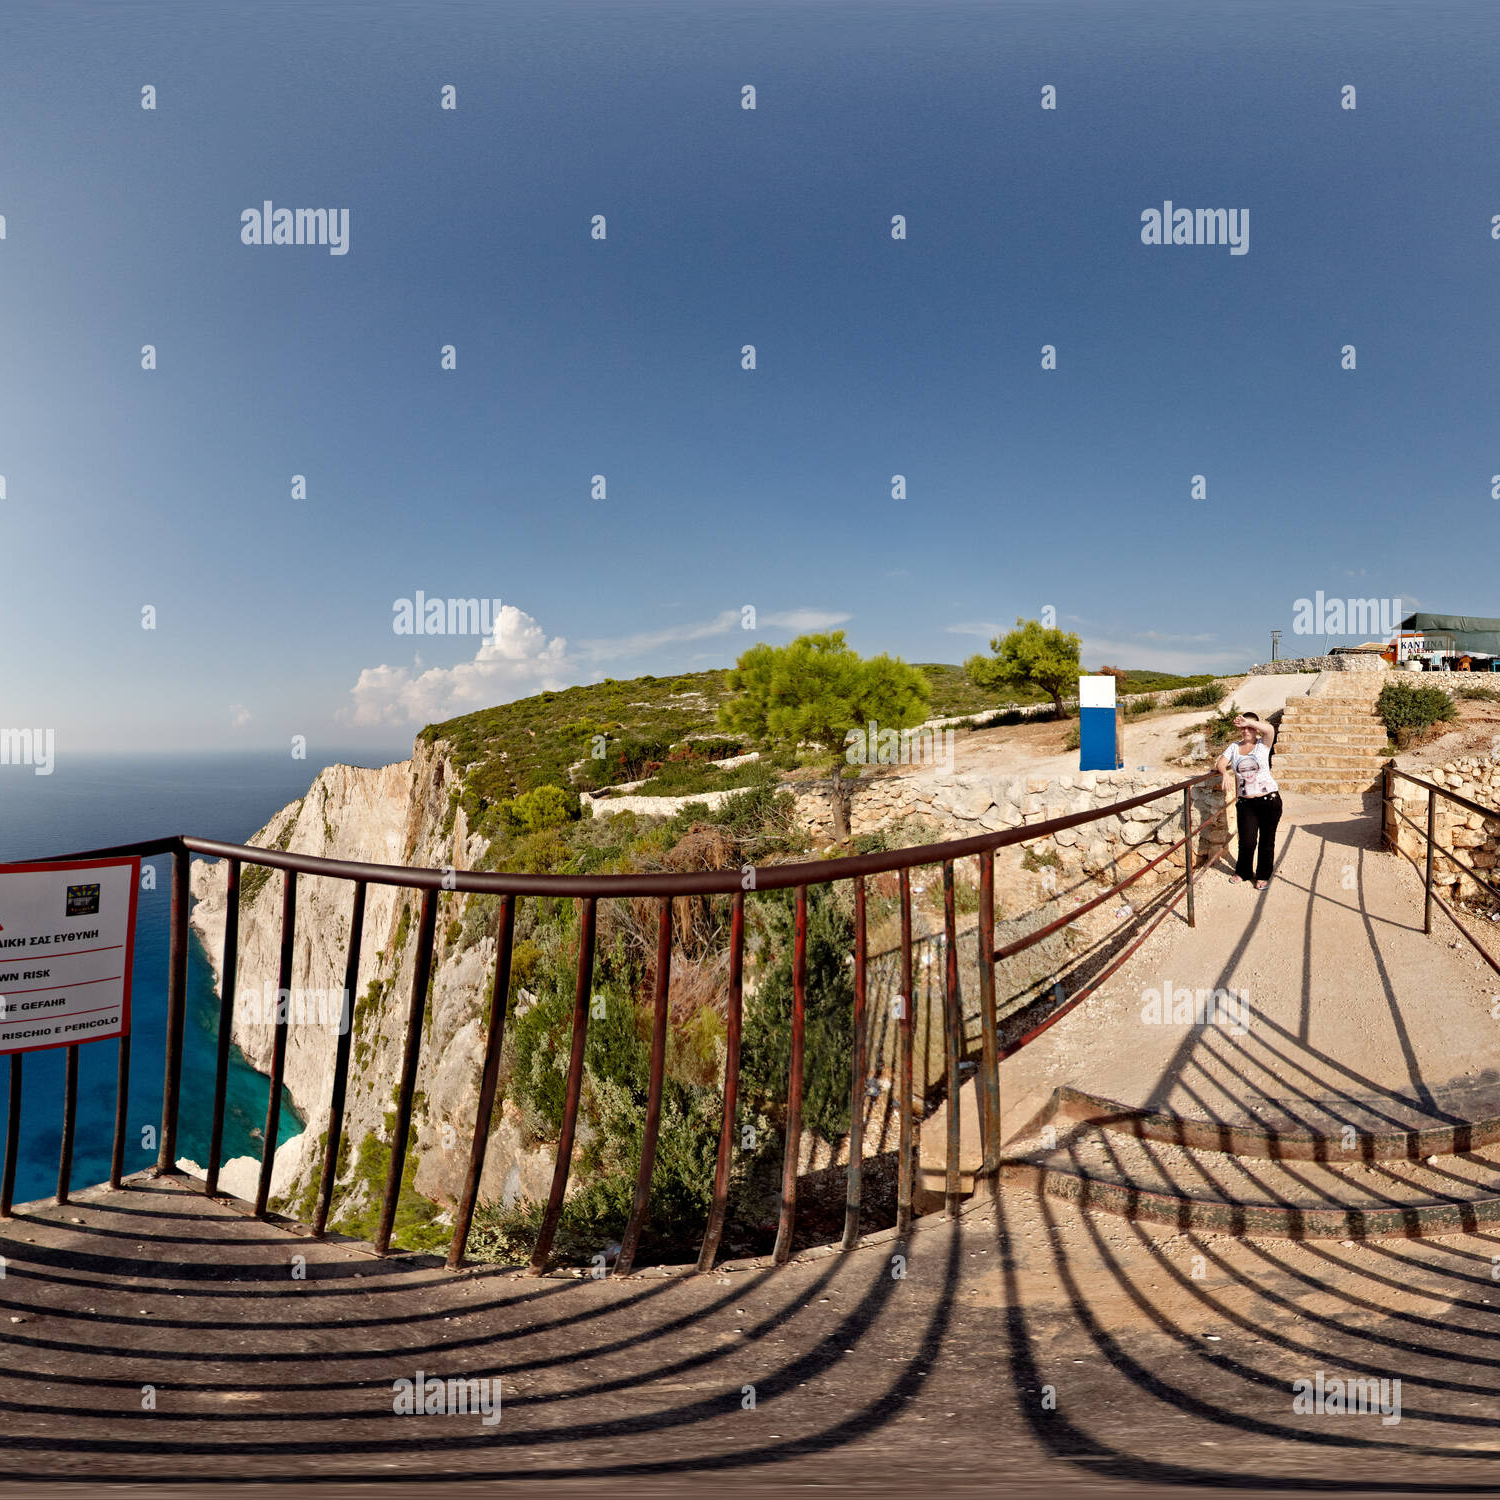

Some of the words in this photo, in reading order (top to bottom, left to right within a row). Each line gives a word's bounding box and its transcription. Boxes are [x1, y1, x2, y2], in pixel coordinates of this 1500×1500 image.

[30, 936, 51, 945] ΣΑΣ
[54, 930, 99, 942] ΕΥΘΥΝΗ
[23, 970, 50, 980] RISK
[21, 998, 66, 1010] GEFAHR
[2, 1028, 51, 1040] RISCHIO
[65, 1017, 118, 1032] PERICOLO
